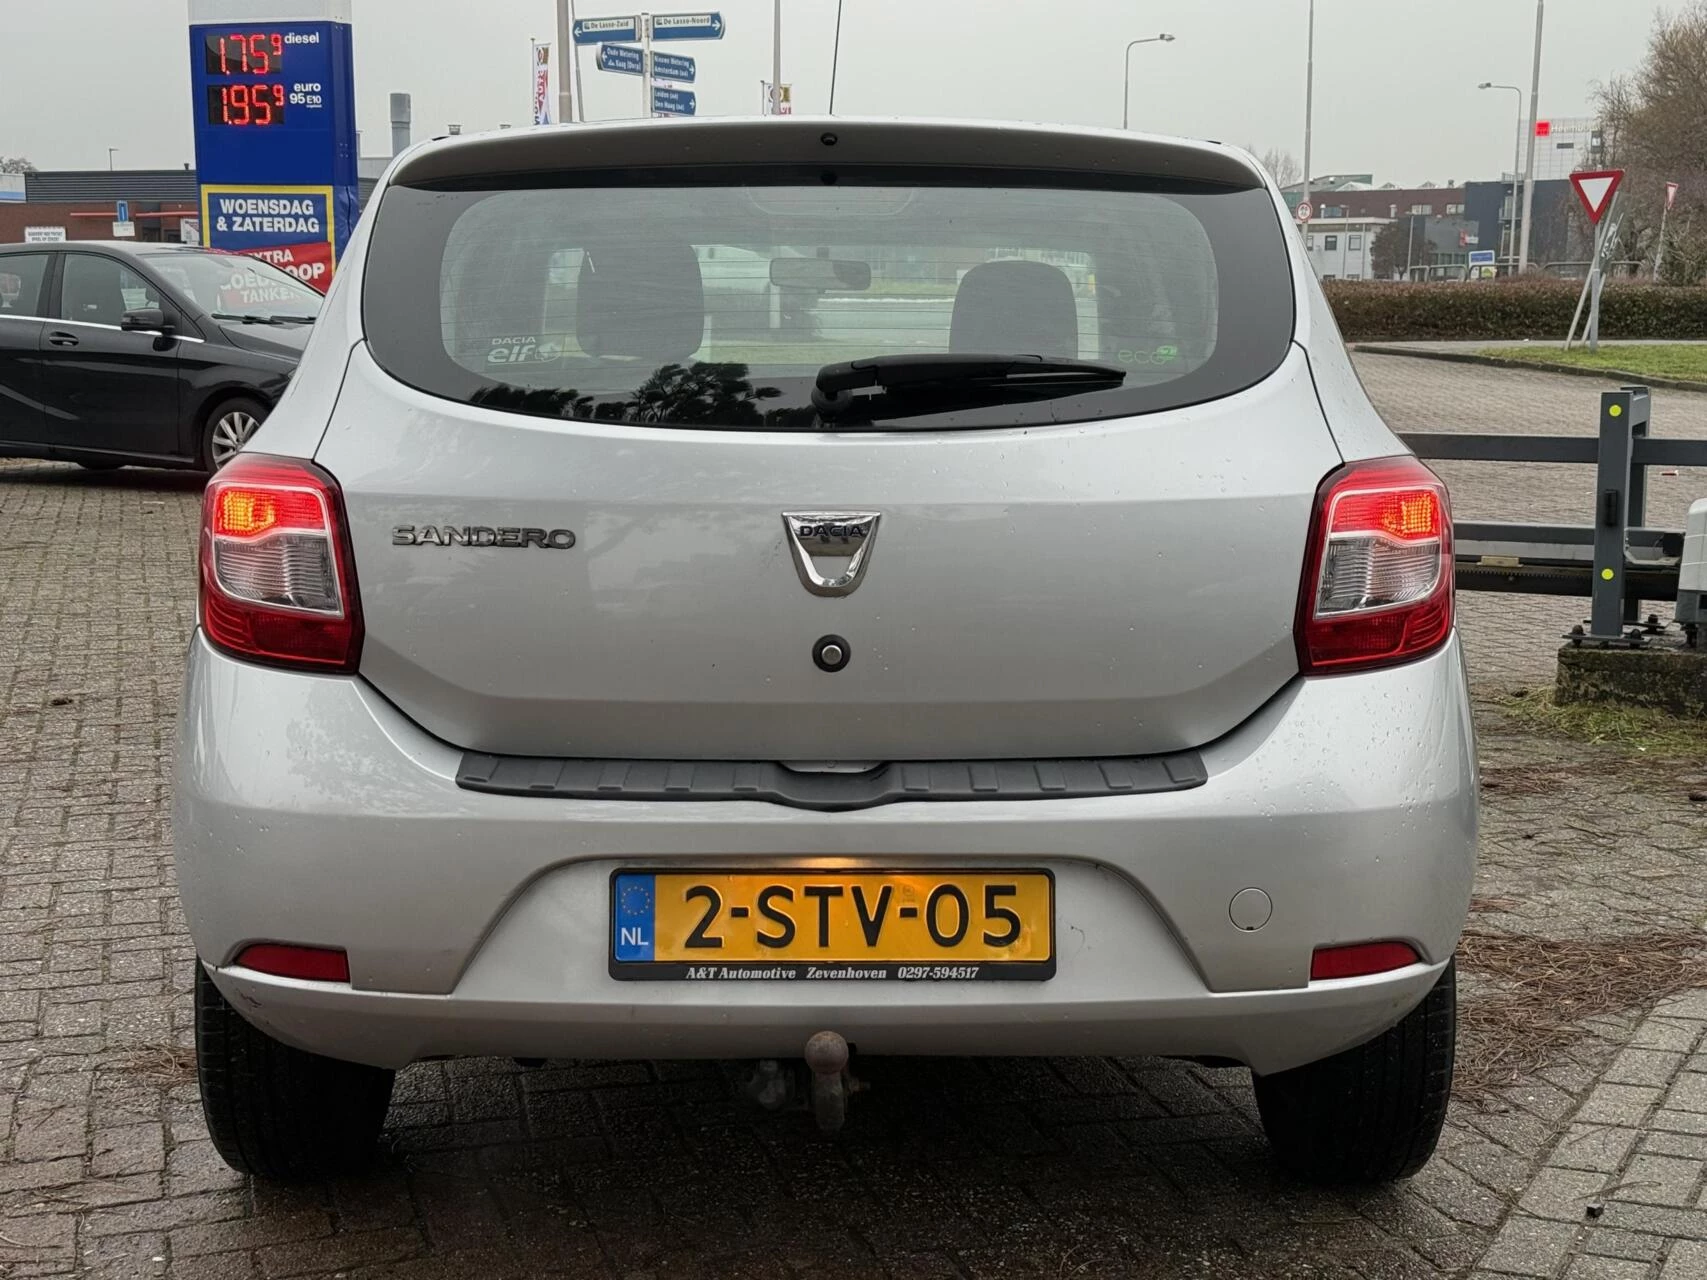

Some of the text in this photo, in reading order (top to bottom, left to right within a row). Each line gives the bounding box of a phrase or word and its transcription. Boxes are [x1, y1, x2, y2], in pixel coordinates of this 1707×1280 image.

[284, 32, 319, 44] diesel
[293, 82, 321, 92] euro
[289, 93, 322, 104] 95 E10
[220, 198, 314, 215] WOENSDAG
[217, 216, 228, 231] &
[232, 217, 319, 233] ZATERDAG
[248, 249, 294, 264] XTRA
[491, 336, 536, 345] DACIA
[487, 345, 536, 363] elf
[391, 525, 576, 550] SANDERO
[800, 525, 863, 537] DACIA
[684, 884, 1021, 949] 2-STV-05
[620, 927, 649, 946] NL
[686, 966, 979, 980] A&T Automotive Zevenhoven 0297-594517
